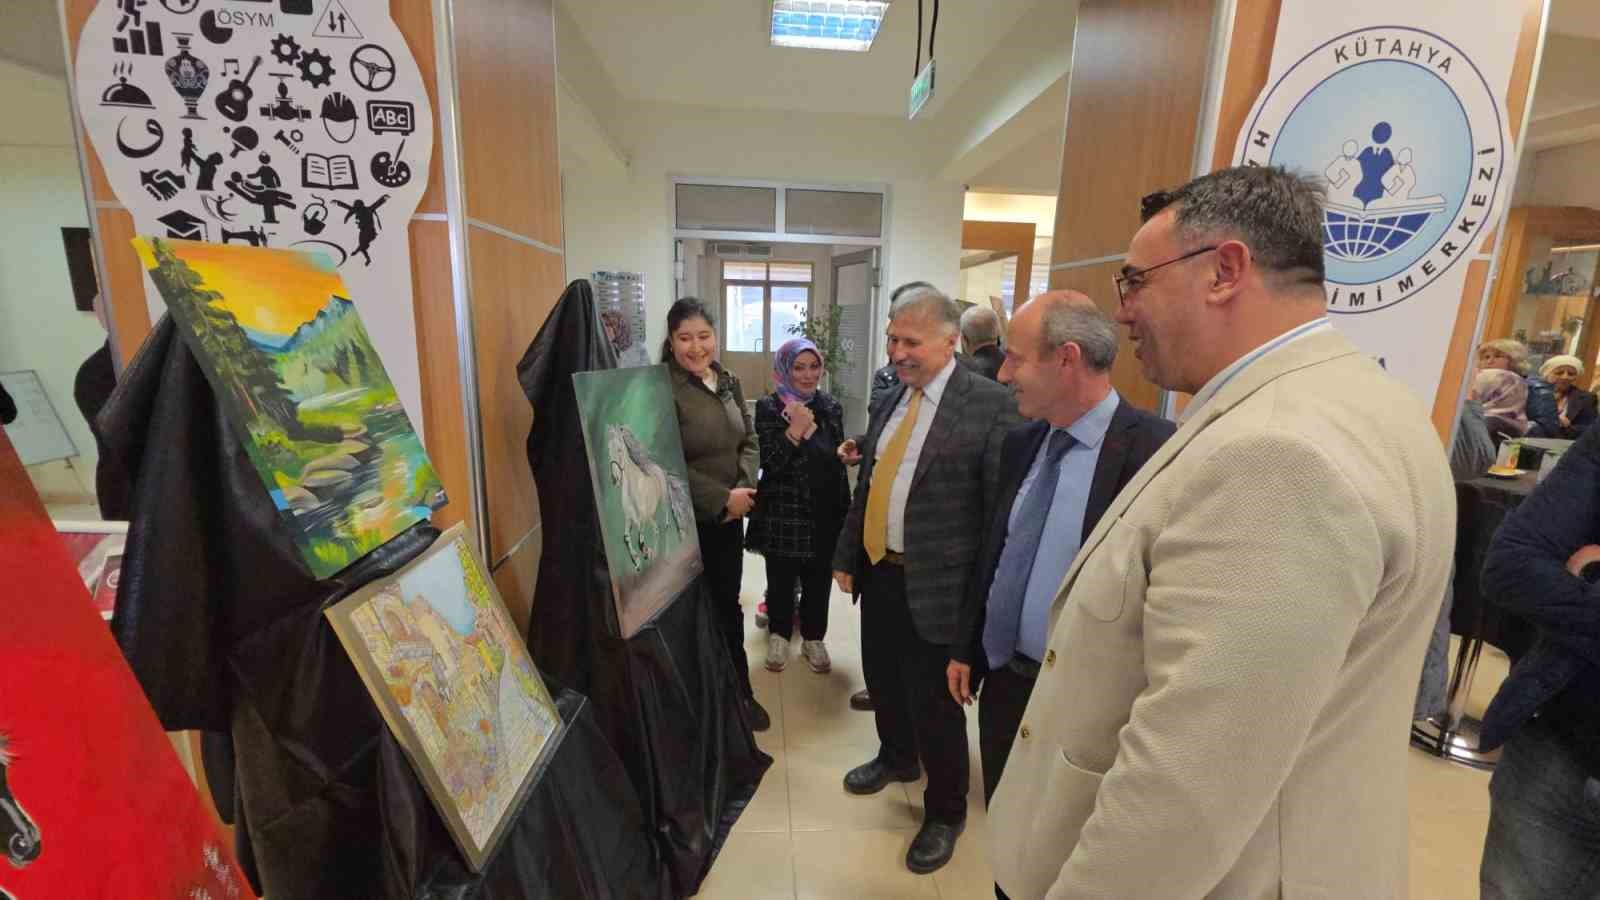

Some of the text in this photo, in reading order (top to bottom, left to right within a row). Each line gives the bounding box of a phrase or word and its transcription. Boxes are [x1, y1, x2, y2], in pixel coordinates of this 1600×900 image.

[217, 8, 274, 28] ÖSYM
[1334, 36, 1452, 74] KÜTAHYA
[1397, 147, 1496, 293] MERKEZİ
